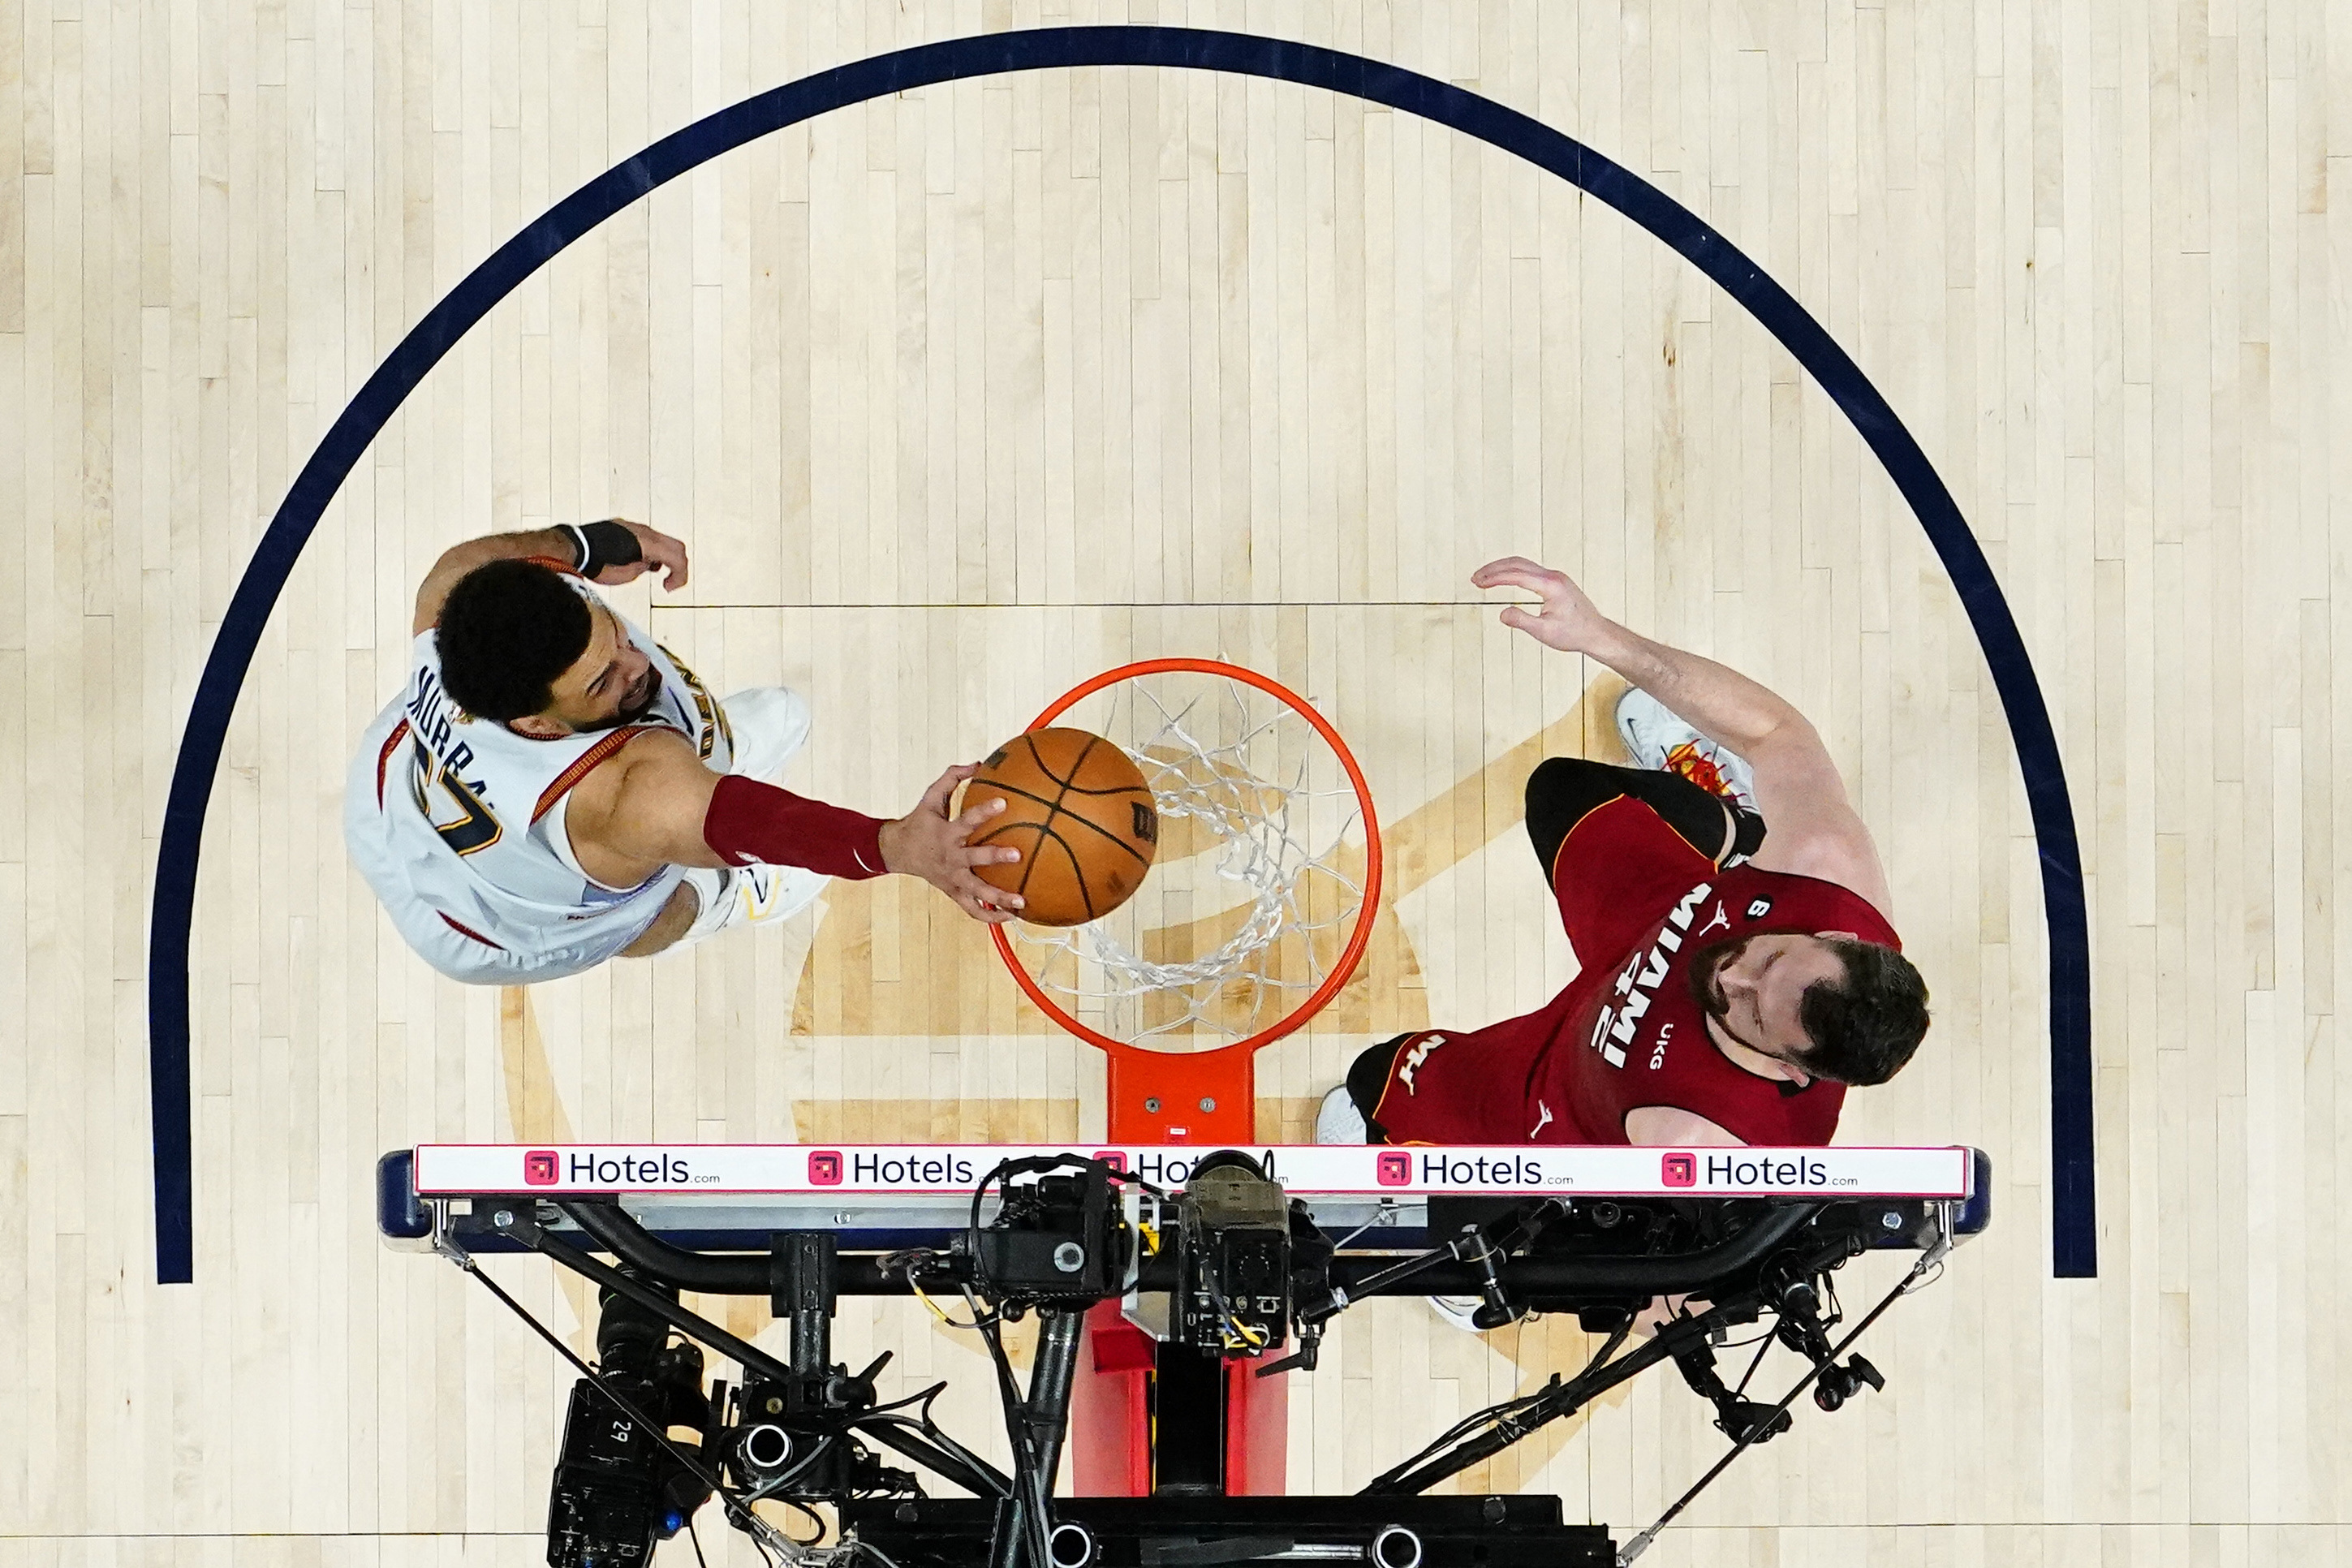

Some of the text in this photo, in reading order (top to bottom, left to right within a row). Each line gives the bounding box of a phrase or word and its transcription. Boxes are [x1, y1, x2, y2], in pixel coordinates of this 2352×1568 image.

[407, 664, 496, 810] MURRA
[1603, 881, 1712, 1069] MIAMI
[1589, 950, 1643, 1053] 42
[1648, 1023, 1674, 1070] UKG
[571, 1152, 721, 1184] Hotels.com
[1423, 1154, 1574, 1185] Hotels.com
[1708, 1155, 1859, 1186] Hotels.com
[610, 1420, 632, 1443] 29
